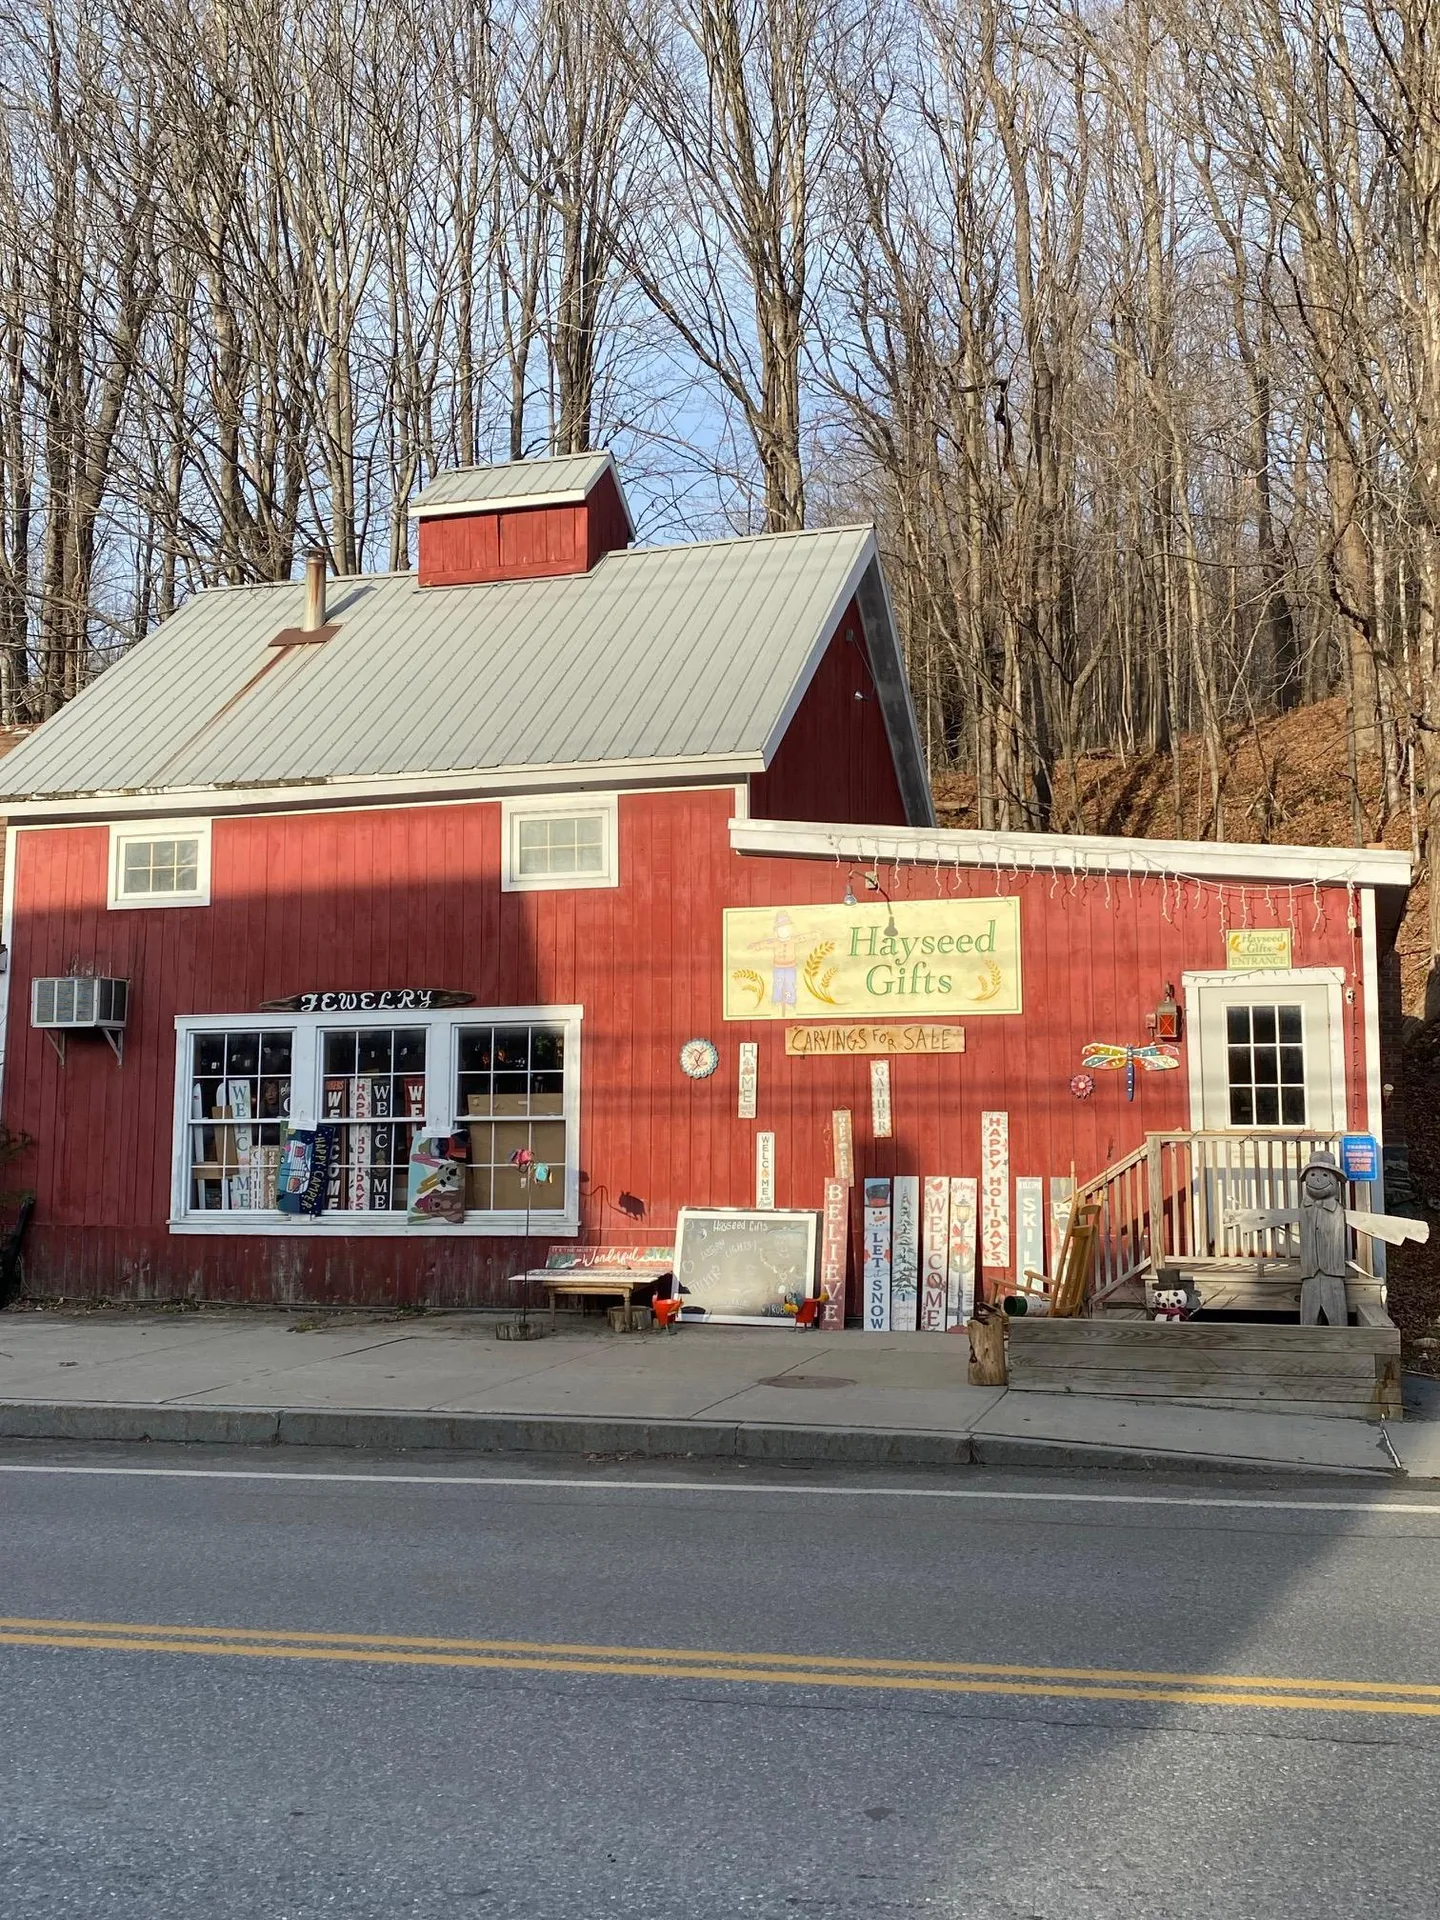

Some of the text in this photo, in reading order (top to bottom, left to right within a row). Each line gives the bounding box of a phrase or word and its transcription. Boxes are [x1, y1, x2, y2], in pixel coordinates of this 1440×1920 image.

[847, 919, 996, 965] Hayseed
[1231, 956, 1287, 966] ENTRANCE
[1242, 932, 1284, 944] Hayseed
[1247, 942, 1272, 953] Gifts
[301, 989, 433, 1011] JEWELRY
[866, 960, 952, 996] Gifts
[791, 1027, 951, 1053] CARVINGS FOR SALE
[742, 1044, 754, 1103] HME
[874, 1066, 888, 1132] GATHER
[232, 1085, 250, 1208] WELCME
[373, 1085, 390, 1210] WELCME
[761, 1135, 771, 1196] WELCME
[301, 1137, 326, 1209] HAPPY CAMPER
[988, 1117, 1002, 1261] HAPPY HOLIDAYS
[713, 1219, 746, 1232] Hayseed
[1022, 1197, 1037, 1243] SKI
[582, 1246, 639, 1267] Wonderful
[824, 1184, 844, 1322] BELIEVE
[872, 1232, 884, 1269] LET
[925, 1198, 946, 1327] WELCOME
[870, 1279, 885, 1330] SNOW
